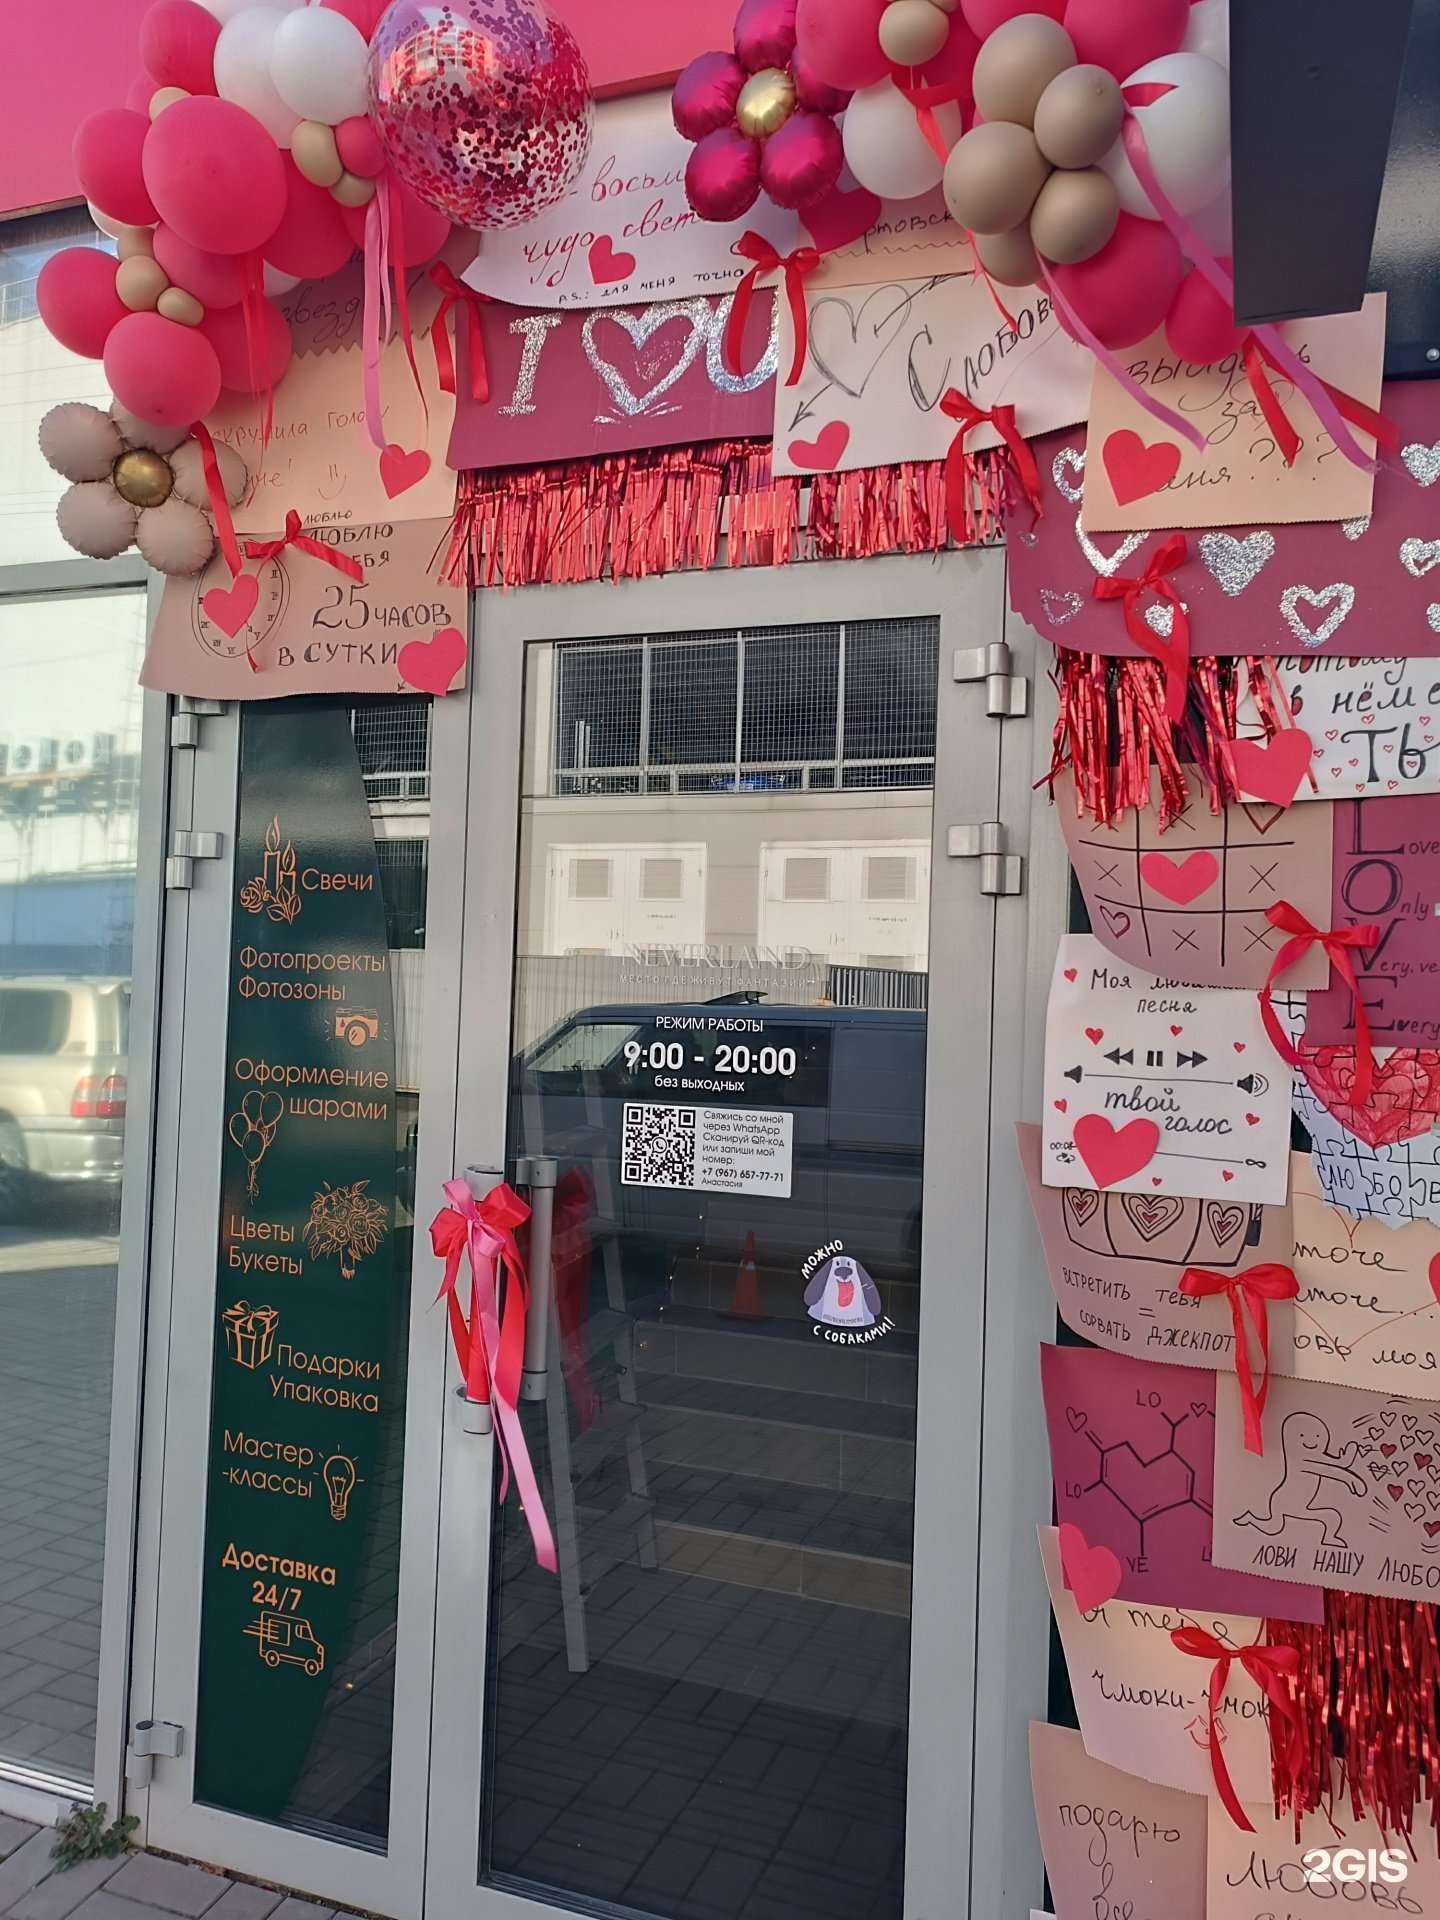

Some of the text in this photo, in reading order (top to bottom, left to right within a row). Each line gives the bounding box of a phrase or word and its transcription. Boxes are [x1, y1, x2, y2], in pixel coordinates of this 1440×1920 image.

[591, 154, 686, 202] восьм
[522, 198, 701, 289] чудо свет
[862, 209, 954, 256] ртовск
[640, 276, 676, 290] МЕНЯ
[498, 312, 563, 416] I
[353, 550, 391, 570] ЕБЯ
[312, 583, 452, 630] 25 ЧАСОВ
[278, 642, 397, 667] В СУТКИ
[1331, 681, 1417, 714] нём
[301, 868, 373, 890] Свечи
[1341, 858, 1430, 921] Only
[239, 945, 386, 973] Фотопроекты
[622, 943, 813, 970] NEVERLAND
[238, 975, 346, 1001] Фотозоны
[1091, 967, 1132, 991] Моя
[1137, 998, 1198, 1014] песня
[655, 1016, 764, 1033] РЕЖИМ РАБОТЫ
[623, 1041, 684, 1070] 9:00
[714, 1044, 796, 1075] 20:00
[235, 1058, 389, 1089] Оформление
[654, 1075, 745, 1092] без выходных
[289, 1096, 388, 1121] шарами
[1104, 1085, 1181, 1112] твой
[703, 1110, 784, 1124] Свяжись со мной
[703, 1123, 780, 1136] через WhatsApp
[1164, 1115, 1233, 1135] голос
[703, 1132, 785, 1147] Сканируй QR-код
[720, 1145, 754, 1155] запиши
[756, 1148, 775, 1157] мой
[702, 1156, 735, 1165] номер:
[702, 1167, 784, 1182] +7 (967) 657-77-71
[701, 1177, 743, 1188] Анастасия
[1328, 1164, 1440, 1204] ЛЮБОВ
[229, 1214, 295, 1243] Цветы
[228, 1246, 303, 1276] Букеты
[801, 1239, 844, 1280] МОЖНО
[1062, 1266, 1202, 1309] ВСТРЕТИТЬ ТЕБЯ
[813, 1324, 821, 1336] С
[824, 1316, 896, 1345] СОБАКАМИ!
[1079, 1309, 1237, 1353] СОРВАТЬ ДЖЕКПОТ
[276, 1343, 381, 1380] Подарки
[1372, 1349, 1438, 1370] моя
[269, 1374, 380, 1413] Упаковка
[1136, 1388, 1162, 1408] LO
[223, 1429, 314, 1470] Мастер
[222, 1466, 313, 1499] -классы
[1065, 1480, 1082, 1499] LO
[221, 1542, 337, 1587] Доставка
[1126, 1556, 1149, 1574] VE
[1252, 1544, 1440, 1588] ЛОВИ НАШУ ЛЮБО
[251, 1580, 303, 1613] 24/7
[1059, 1804, 1181, 1867] подарю
